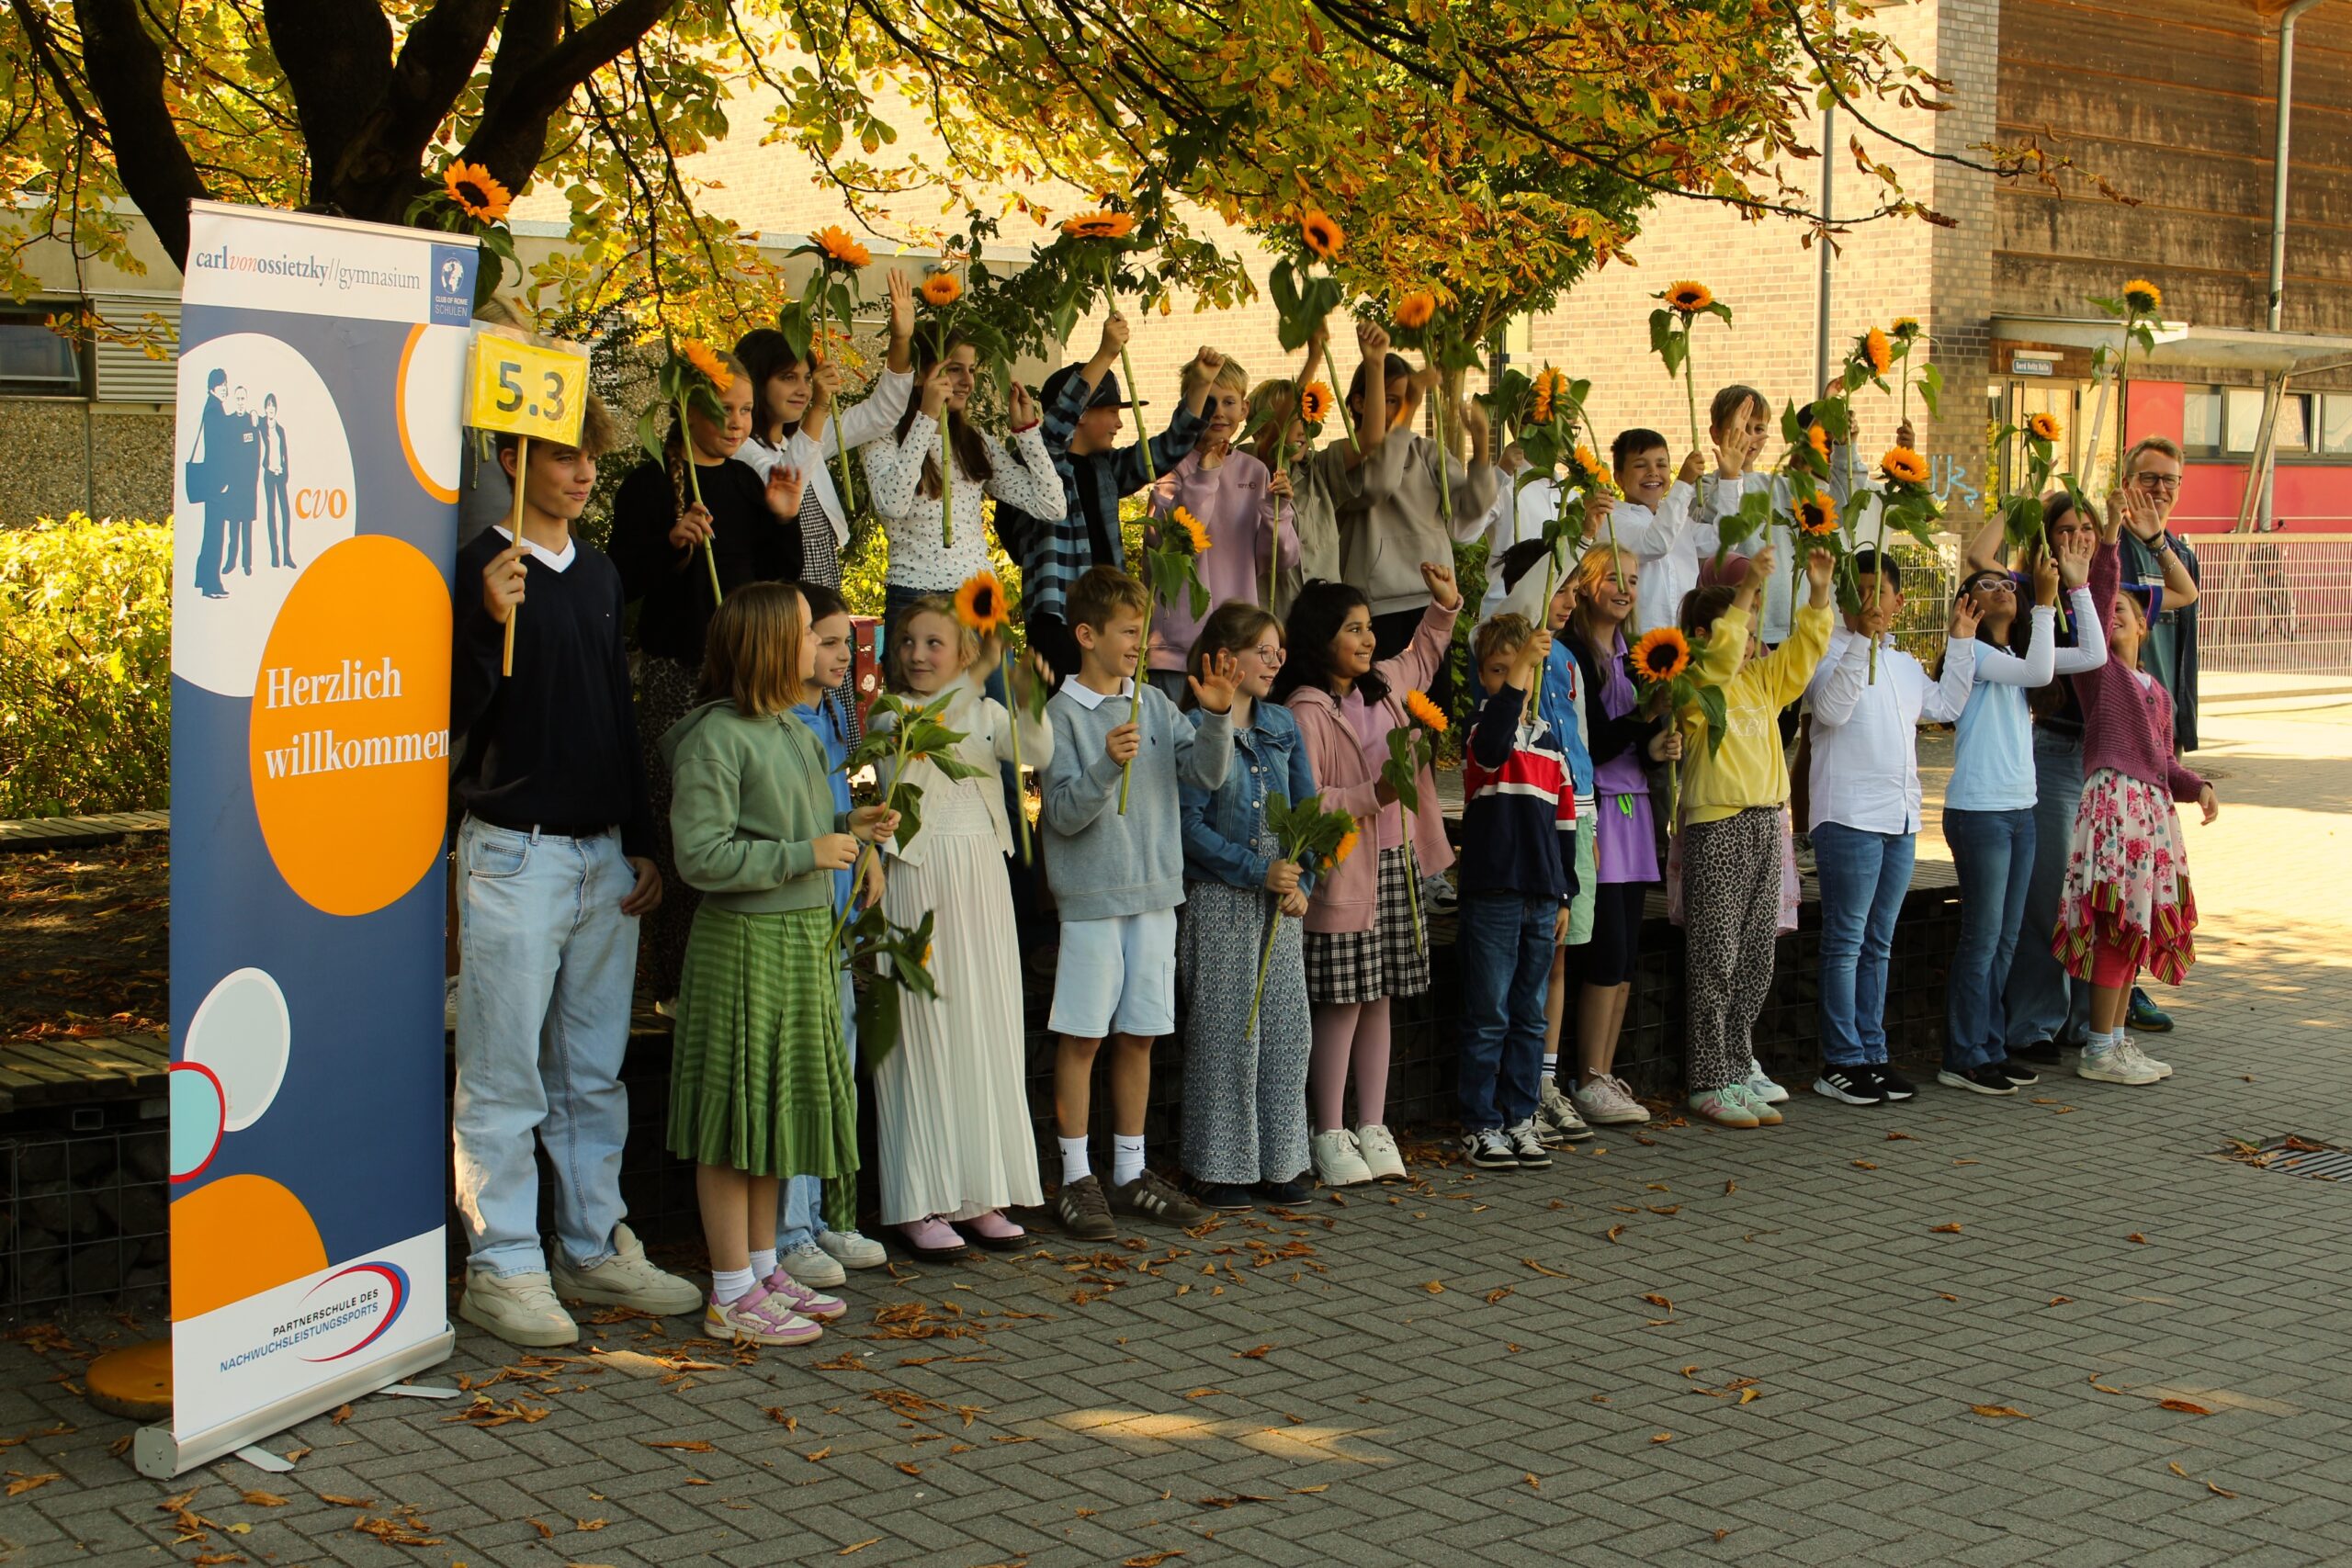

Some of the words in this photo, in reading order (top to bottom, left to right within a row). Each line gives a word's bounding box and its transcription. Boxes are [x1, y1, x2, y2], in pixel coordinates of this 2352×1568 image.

[435, 304, 468, 316] SCHULEN
[496, 361, 565, 422] 5.3
[295, 488, 347, 520] cvo
[265, 657, 402, 709] Herzlich
[264, 728, 449, 779] willkommen
[220, 1302, 379, 1373] NACHWUCHSLEISTUNGSSPORTS
[273, 1296, 357, 1337] PARTNERSCHULE
[360, 1289, 379, 1303] DES
